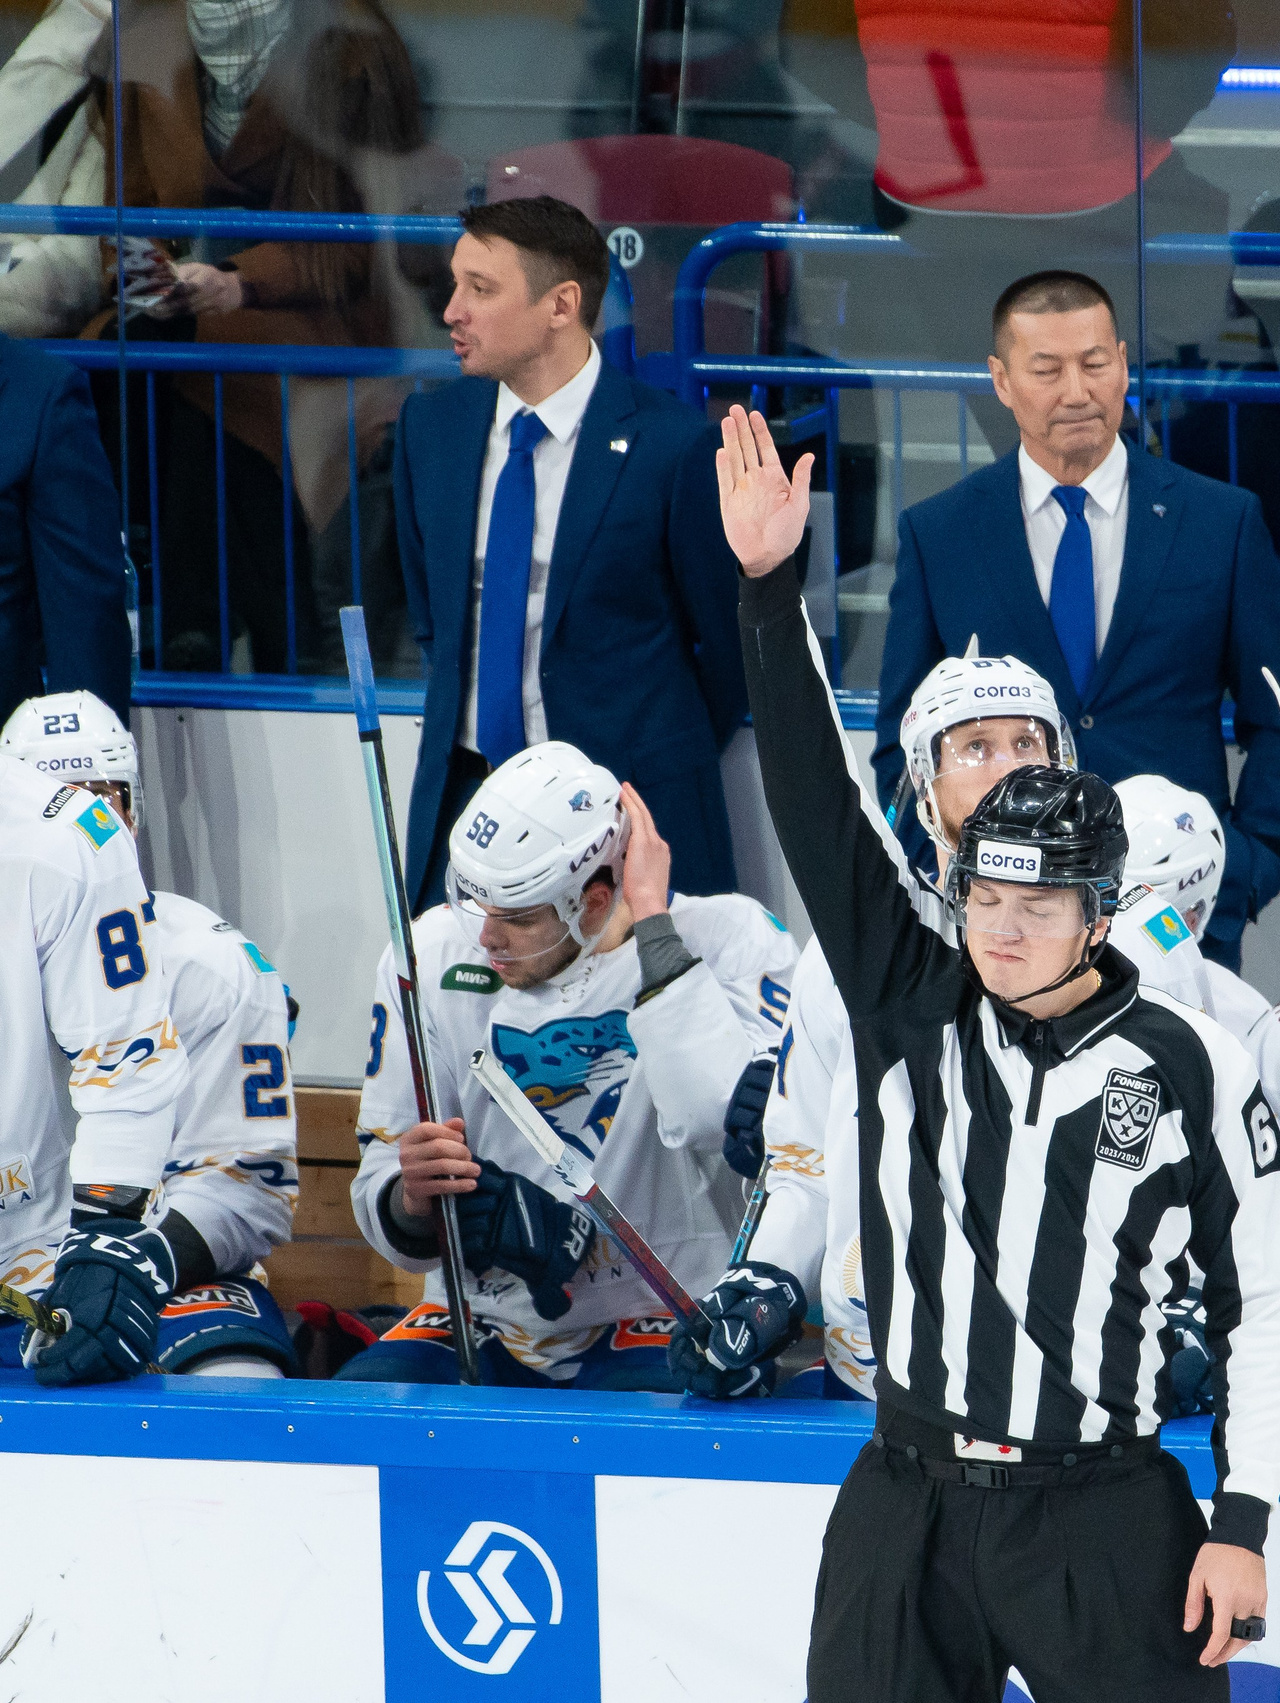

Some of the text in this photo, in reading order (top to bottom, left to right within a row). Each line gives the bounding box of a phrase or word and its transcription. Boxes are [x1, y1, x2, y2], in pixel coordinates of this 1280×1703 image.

[974, 685, 1032, 699] согаз
[43, 712, 81, 736] 23
[36, 756, 93, 773] согаз
[466, 811, 500, 850] 58
[980, 852, 1037, 872] согаз
[454, 970, 491, 985] МИР
[1112, 1074, 1156, 1094] FONBET
[1250, 1101, 1278, 1170] 6
[1098, 1145, 1141, 1165] 2023/2024
[736, 1328, 751, 1356] CCM
